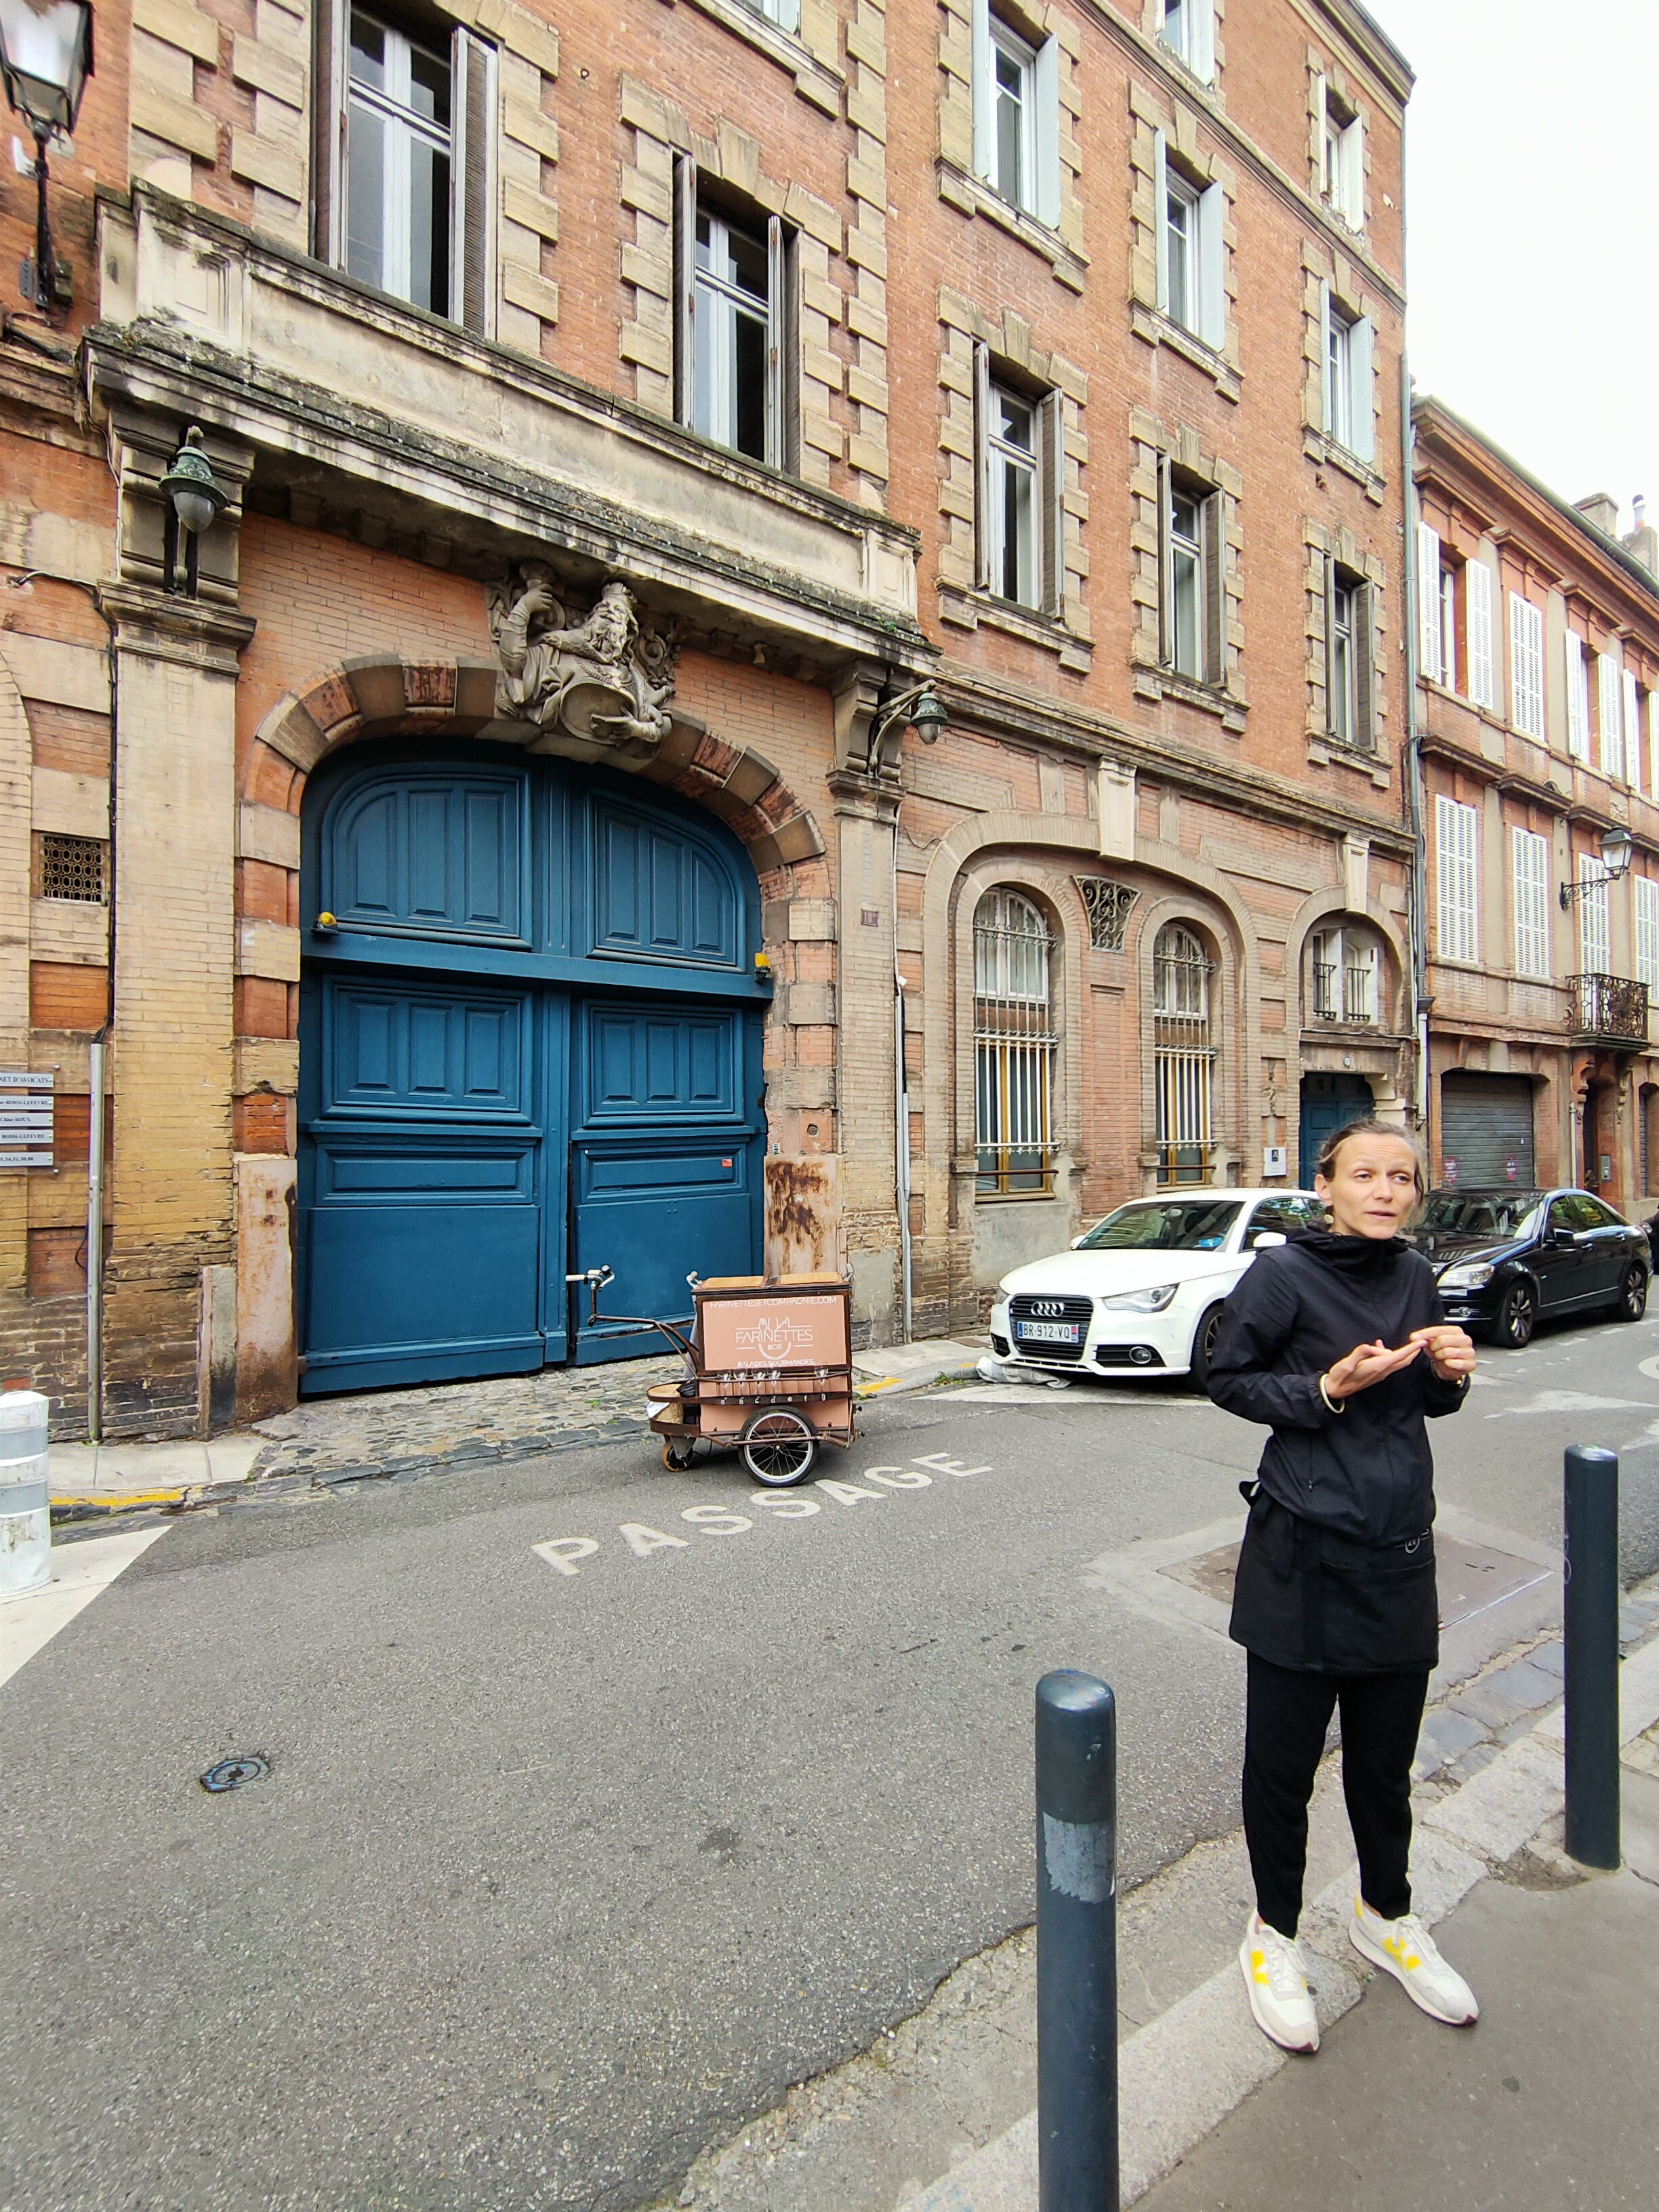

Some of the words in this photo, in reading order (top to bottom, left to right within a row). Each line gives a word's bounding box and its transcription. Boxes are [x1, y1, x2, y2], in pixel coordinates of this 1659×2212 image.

[735, 1328, 814, 1344] FARINETTES
[737, 1359, 767, 1368] BALADES
[768, 1357, 815, 1367] GOURMANDES
[531, 1452, 994, 1576] PASSAGE
